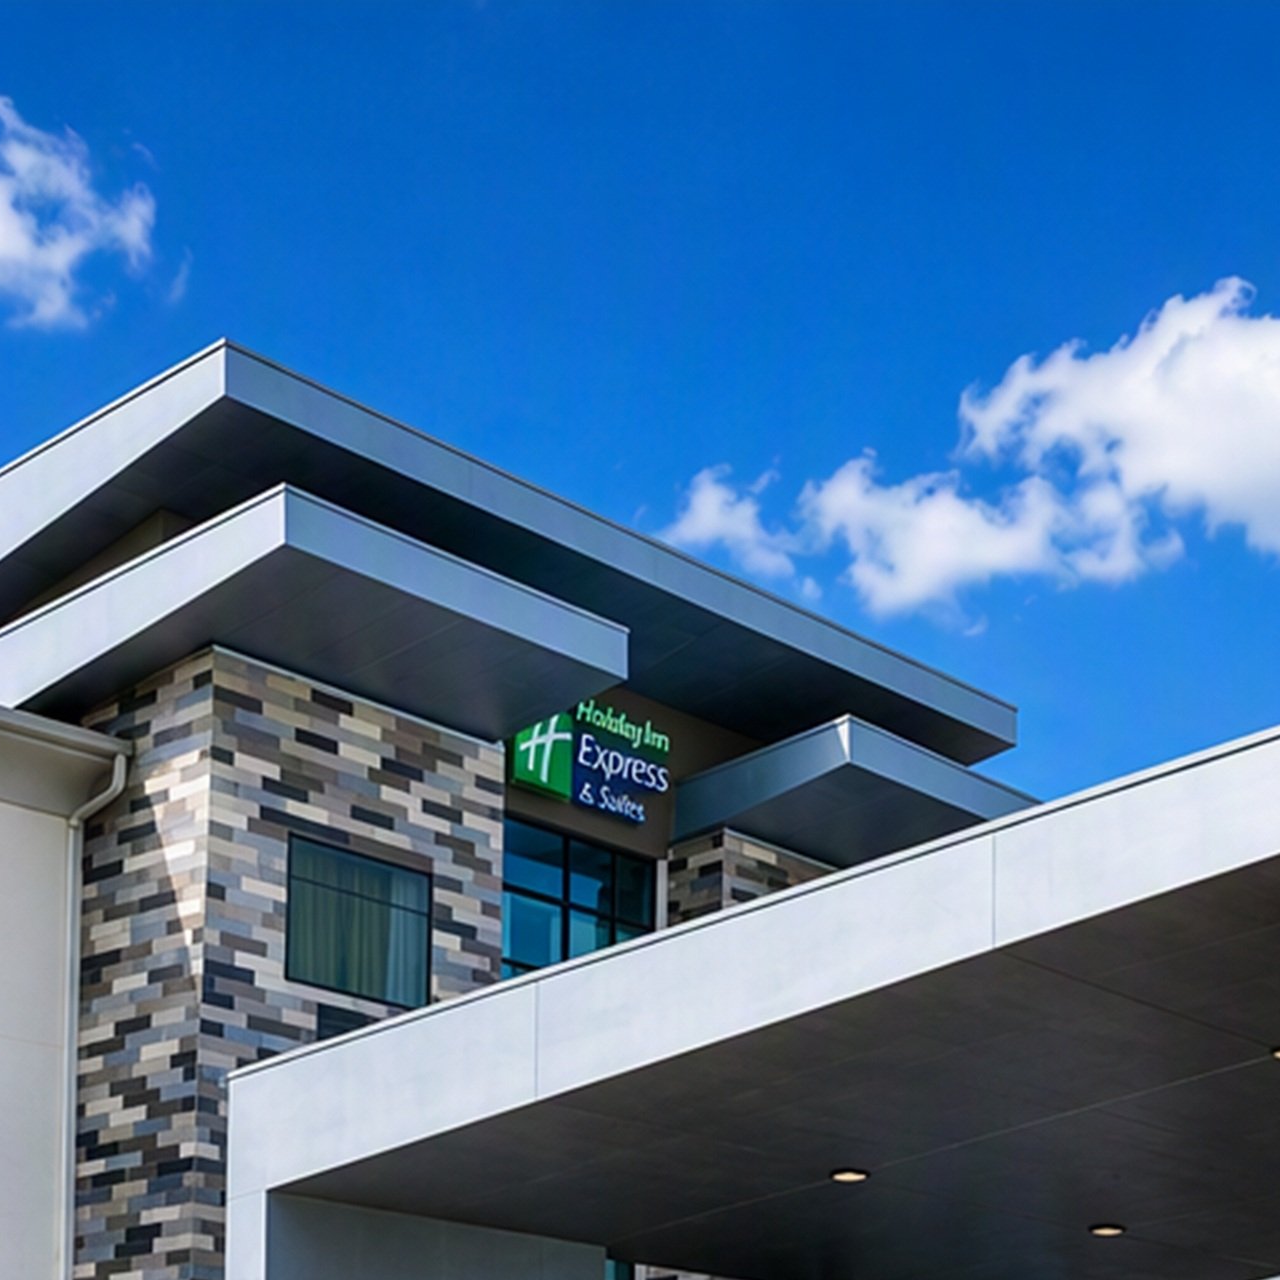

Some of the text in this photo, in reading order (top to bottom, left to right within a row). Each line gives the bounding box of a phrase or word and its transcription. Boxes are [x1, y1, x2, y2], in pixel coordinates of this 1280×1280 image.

[576, 699, 643, 749] Holiday
[577, 733, 669, 793] Express
[597, 785, 647, 823] Suites
